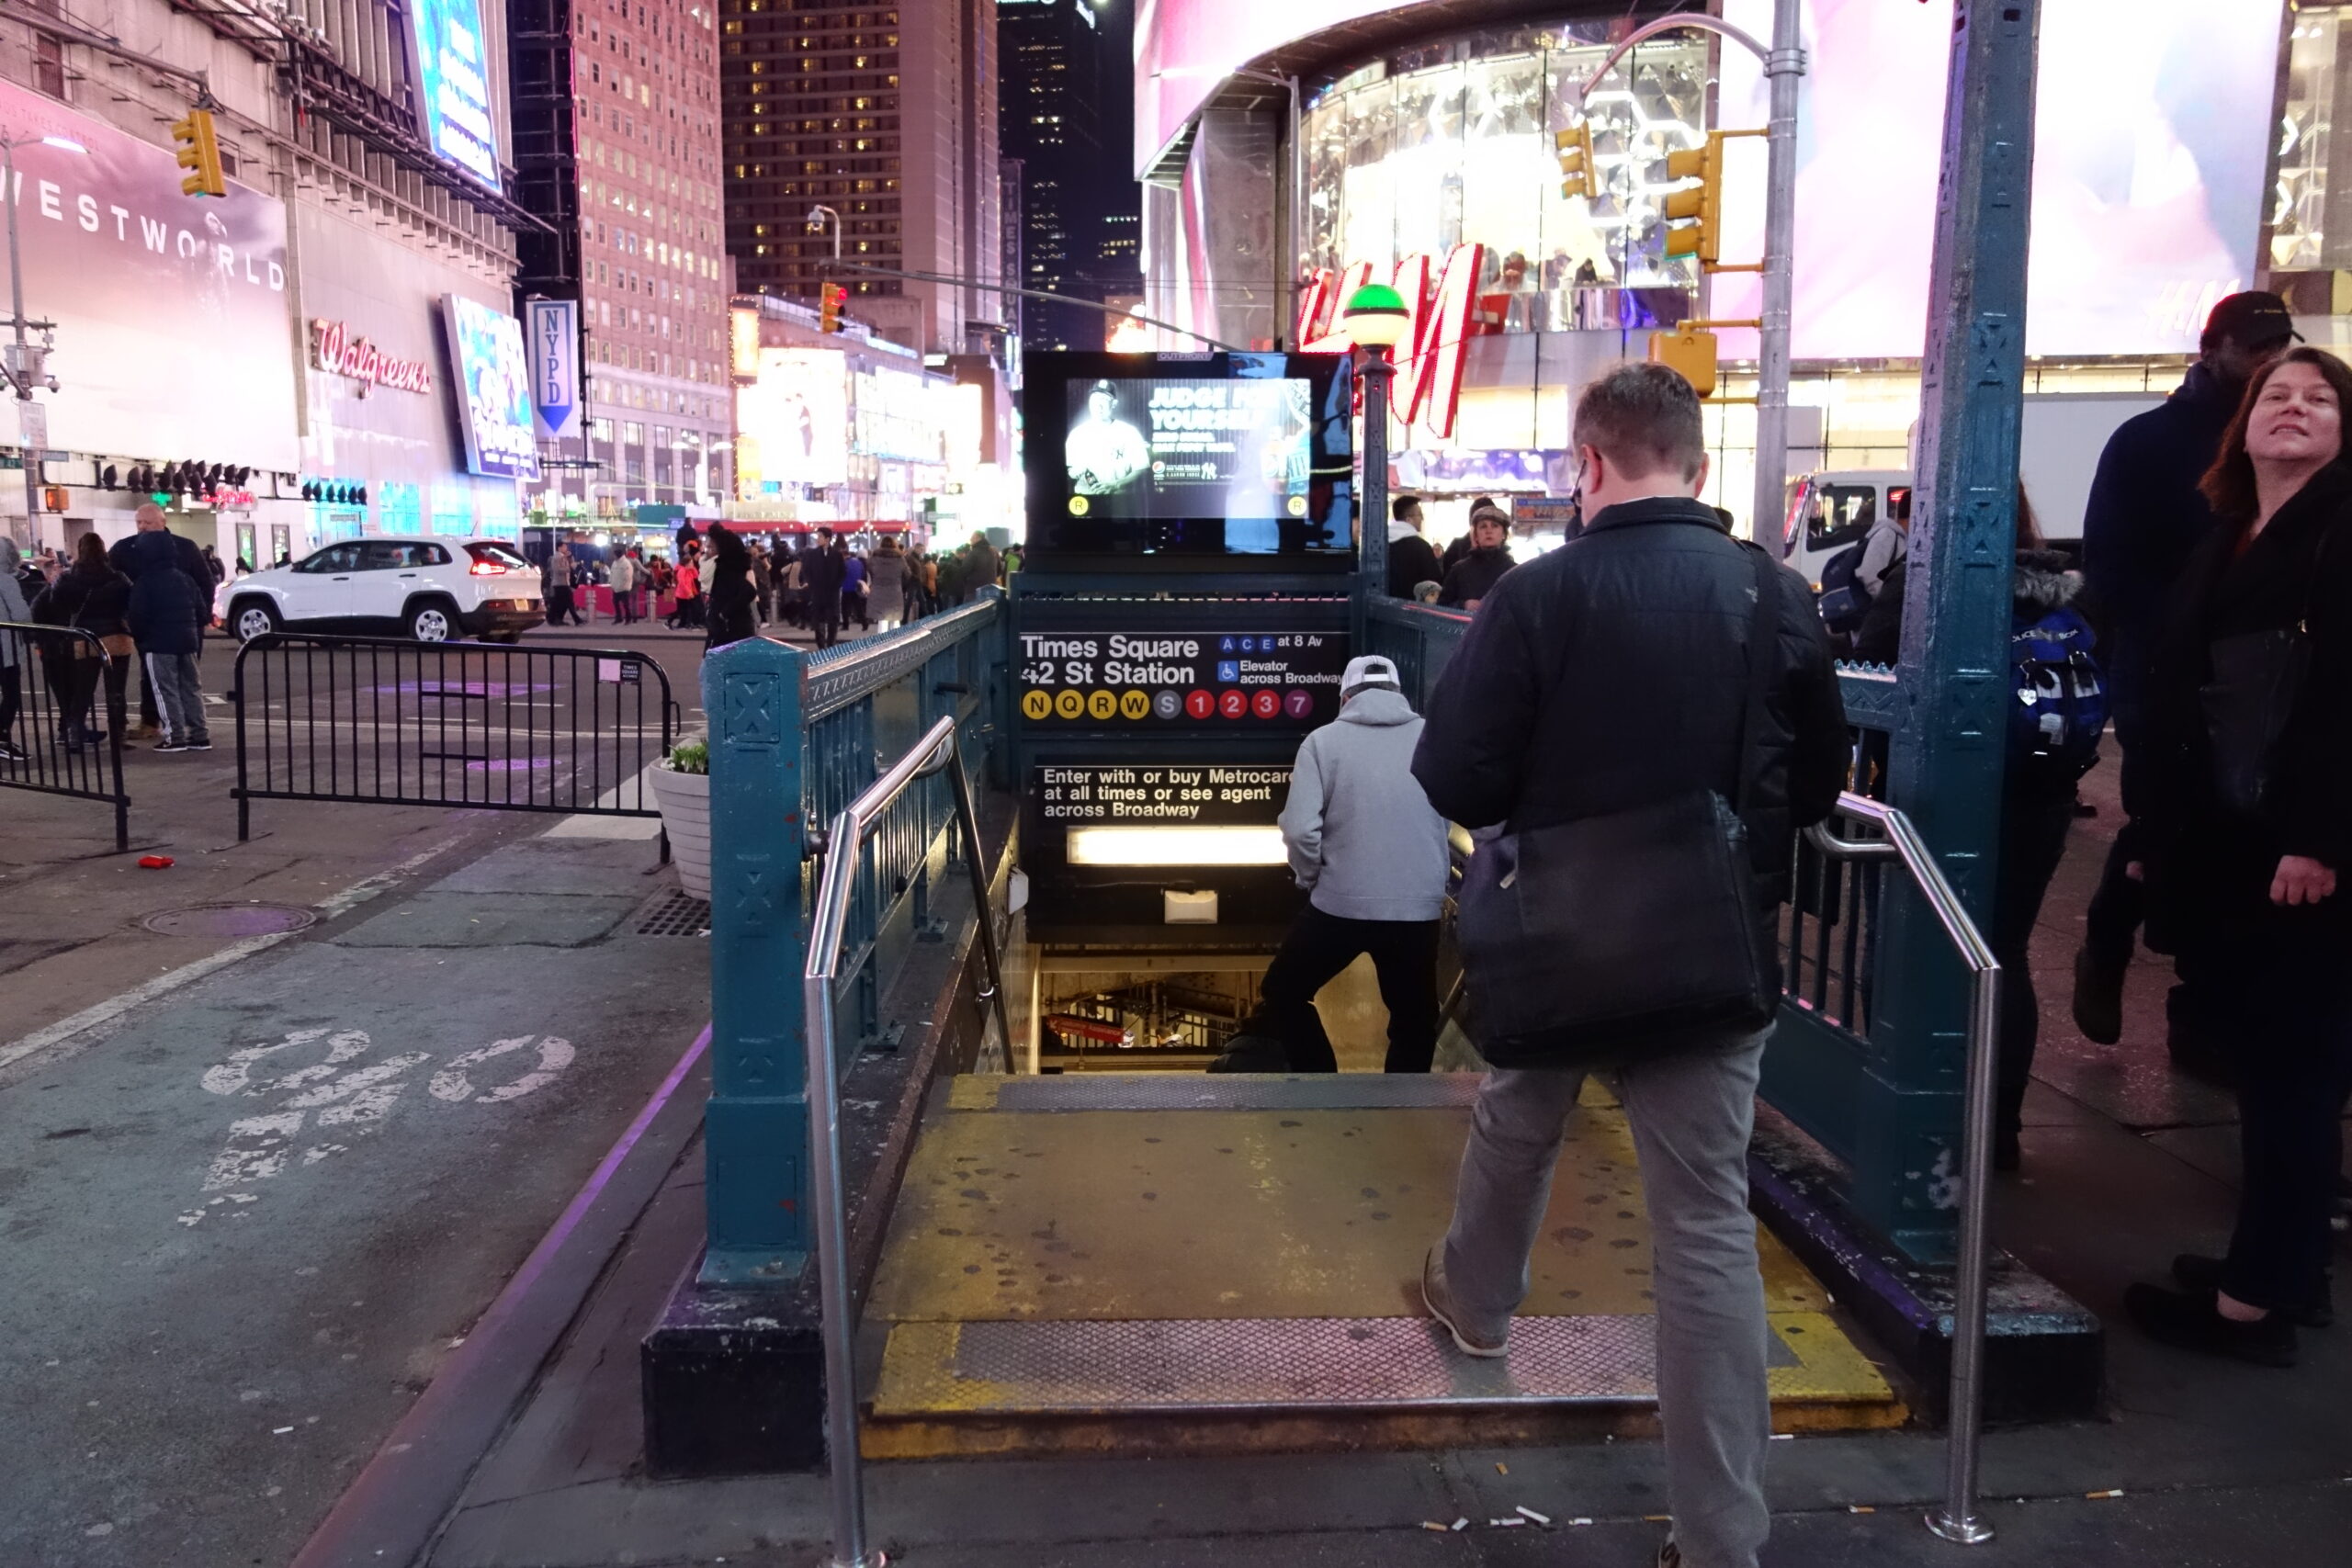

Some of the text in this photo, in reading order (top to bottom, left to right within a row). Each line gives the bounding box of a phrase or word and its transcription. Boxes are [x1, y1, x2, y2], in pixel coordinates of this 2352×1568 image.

[315, 318, 431, 399] Walgreens
[544, 310, 561, 404] NYPD
[1148, 388, 1227, 408] JUDGE
[1020, 635, 1199, 661] Times Square
[1277, 636, 1290, 647] at
[1294, 635, 1304, 647] 8
[1307, 635, 1323, 647] Av
[1021, 660, 1195, 684] 42 St Station
[1240, 660, 1288, 671] Elevator
[1240, 673, 1281, 683] across
[1044, 769, 1091, 784] Enter
[1099, 769, 1136, 784] with
[1143, 772, 1161, 784] or
[1169, 769, 1202, 786] buy
[1045, 785, 1272, 804] at all times or see agent
[1045, 802, 1200, 819] across Broadway
